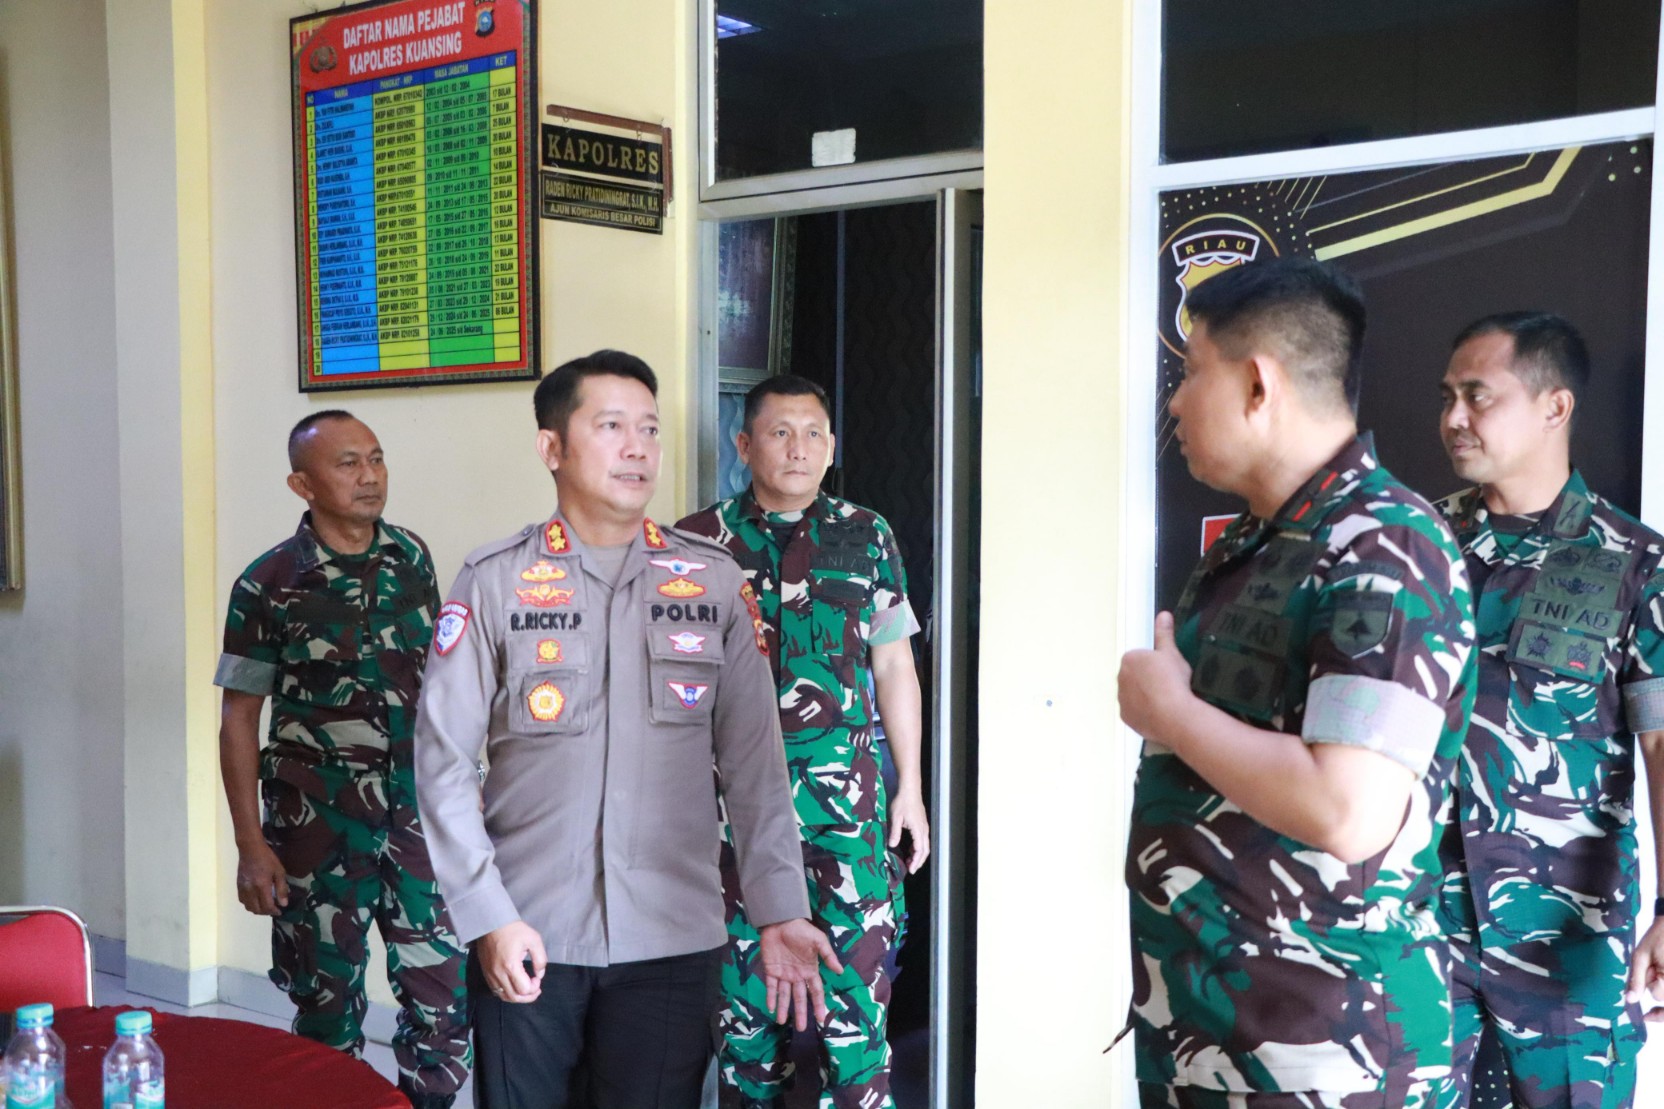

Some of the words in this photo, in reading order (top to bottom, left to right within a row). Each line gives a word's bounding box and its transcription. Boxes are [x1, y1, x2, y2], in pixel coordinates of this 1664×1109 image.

[344, 23, 382, 48] DAFTAR
[385, 14, 415, 39] NAMA
[418, 2, 465, 33] PEJABAT
[349, 46, 404, 75] KAPOLRES
[406, 32, 462, 61] KUANSING
[495, 55, 506, 66] KET
[497, 86, 510, 97] BULAN
[495, 101, 508, 112] BULAN
[498, 115, 511, 126] BULAN
[498, 130, 511, 140] BULAN
[498, 145, 511, 155] BULAN
[547, 134, 660, 174] KAPOLRES
[499, 159, 511, 170] BULAN
[499, 174, 512, 184] BULAN
[499, 189, 512, 199] BULAN
[546, 180, 565, 198] RADEN
[566, 184, 584, 200] RICKY
[499, 203, 512, 213] BULAN
[550, 205, 570, 215] AJUN
[571, 206, 609, 221] KOMISARIS
[611, 211, 633, 224] BESAR
[634, 214, 656, 227] POLISI
[499, 218, 512, 228] BULAN
[500, 233, 512, 242] BULAN
[500, 247, 512, 257] BULAN
[1185, 239, 1248, 256] RIAU
[500, 262, 513, 271] BULAN
[500, 276, 513, 285] BULAN
[500, 291, 513, 300] BULAN
[501, 305, 513, 315] BULAN
[651, 603, 718, 623] POLRI
[1531, 599, 1569, 620] TNI
[1576, 609, 1609, 630] AD
[511, 612, 582, 631] R.RICKY.P
